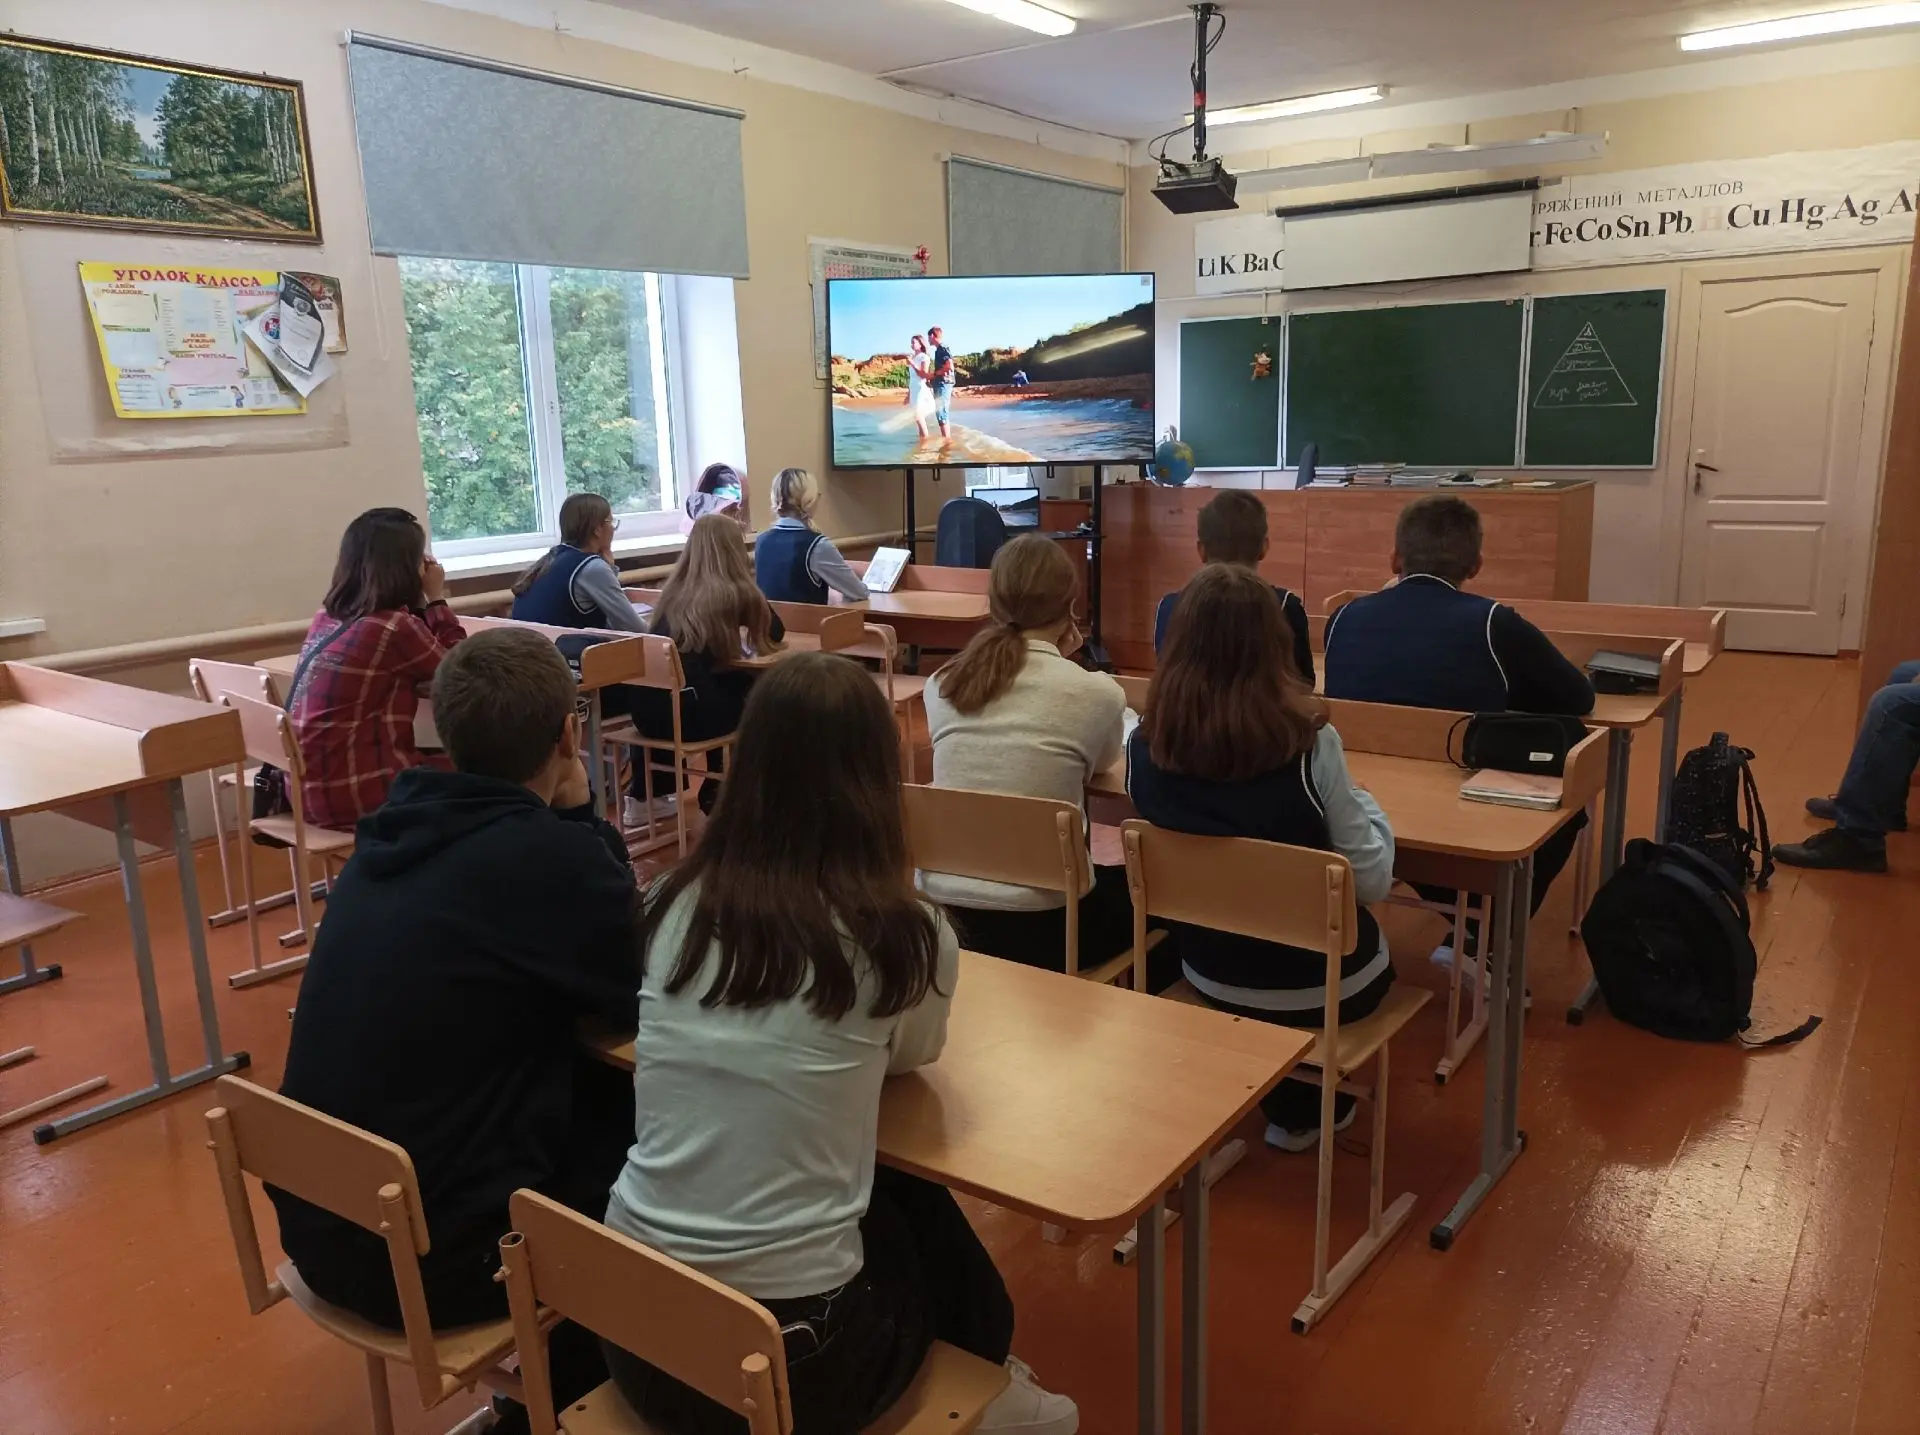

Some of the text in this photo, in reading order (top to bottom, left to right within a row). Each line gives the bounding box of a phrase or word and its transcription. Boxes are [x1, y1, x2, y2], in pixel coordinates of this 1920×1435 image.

[1637, 179, 1744, 205] МЕТАЛЛОВ
[113, 268, 262, 288] УГОЛОК КЛАССА
